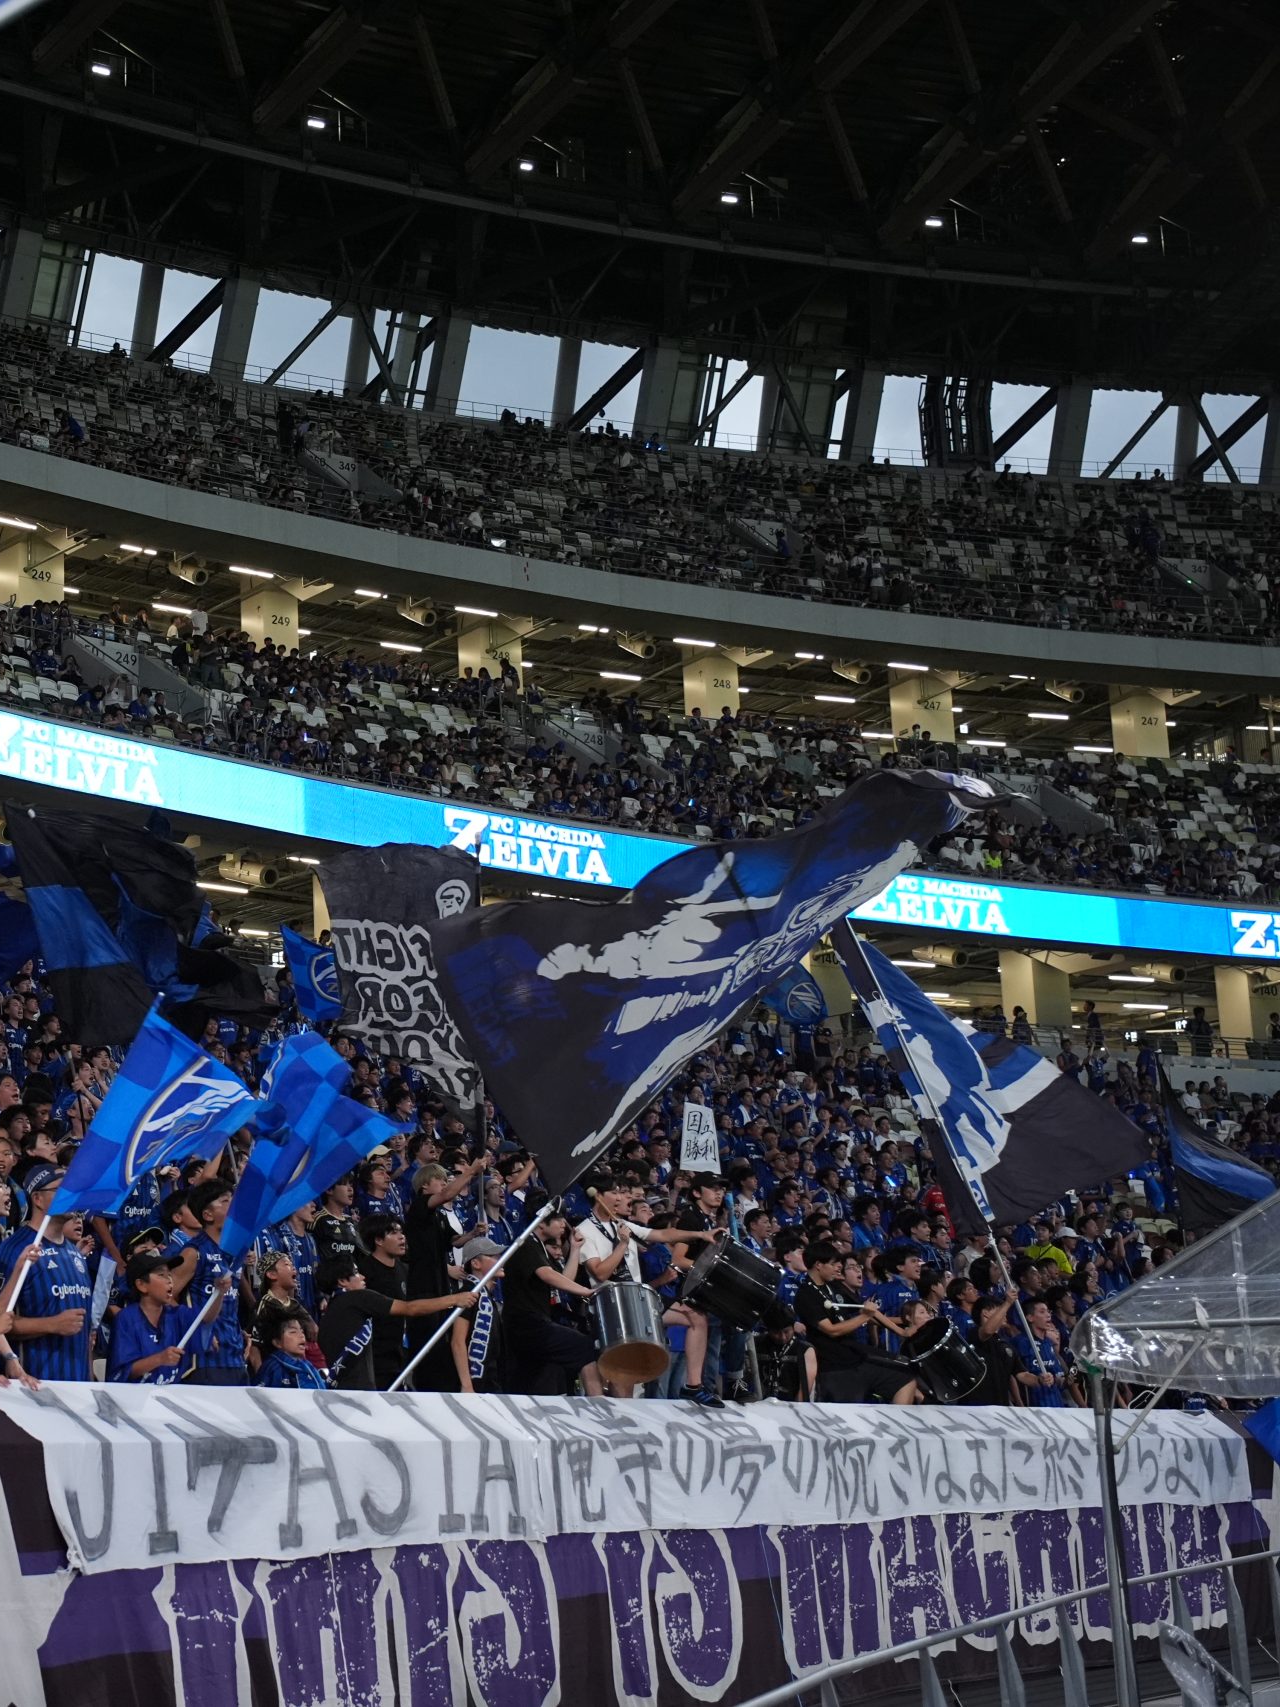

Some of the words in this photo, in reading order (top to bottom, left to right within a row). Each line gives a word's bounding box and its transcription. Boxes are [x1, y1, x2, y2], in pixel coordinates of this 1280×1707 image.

[31, 569, 51, 583] 249
[271, 615, 291, 626] 249
[115, 651, 137, 666] 249
[713, 678, 731, 689] 248
[924, 700, 941, 711] 247
[1141, 716, 1159, 726] 247
[22, 720, 50, 741] FC
[56, 728, 159, 766] MACHIDA
[583, 733, 603, 745] 248
[489, 815, 514, 834] FC
[518, 820, 606, 849] MACHIDA
[444, 807, 613, 884] ZELVIA
[896, 877, 918, 892] FC
[923, 879, 1004, 902] MACHIDA
[686, 1110, 714, 1135] 国立
[683, 1136, 717, 1162] 勝利
